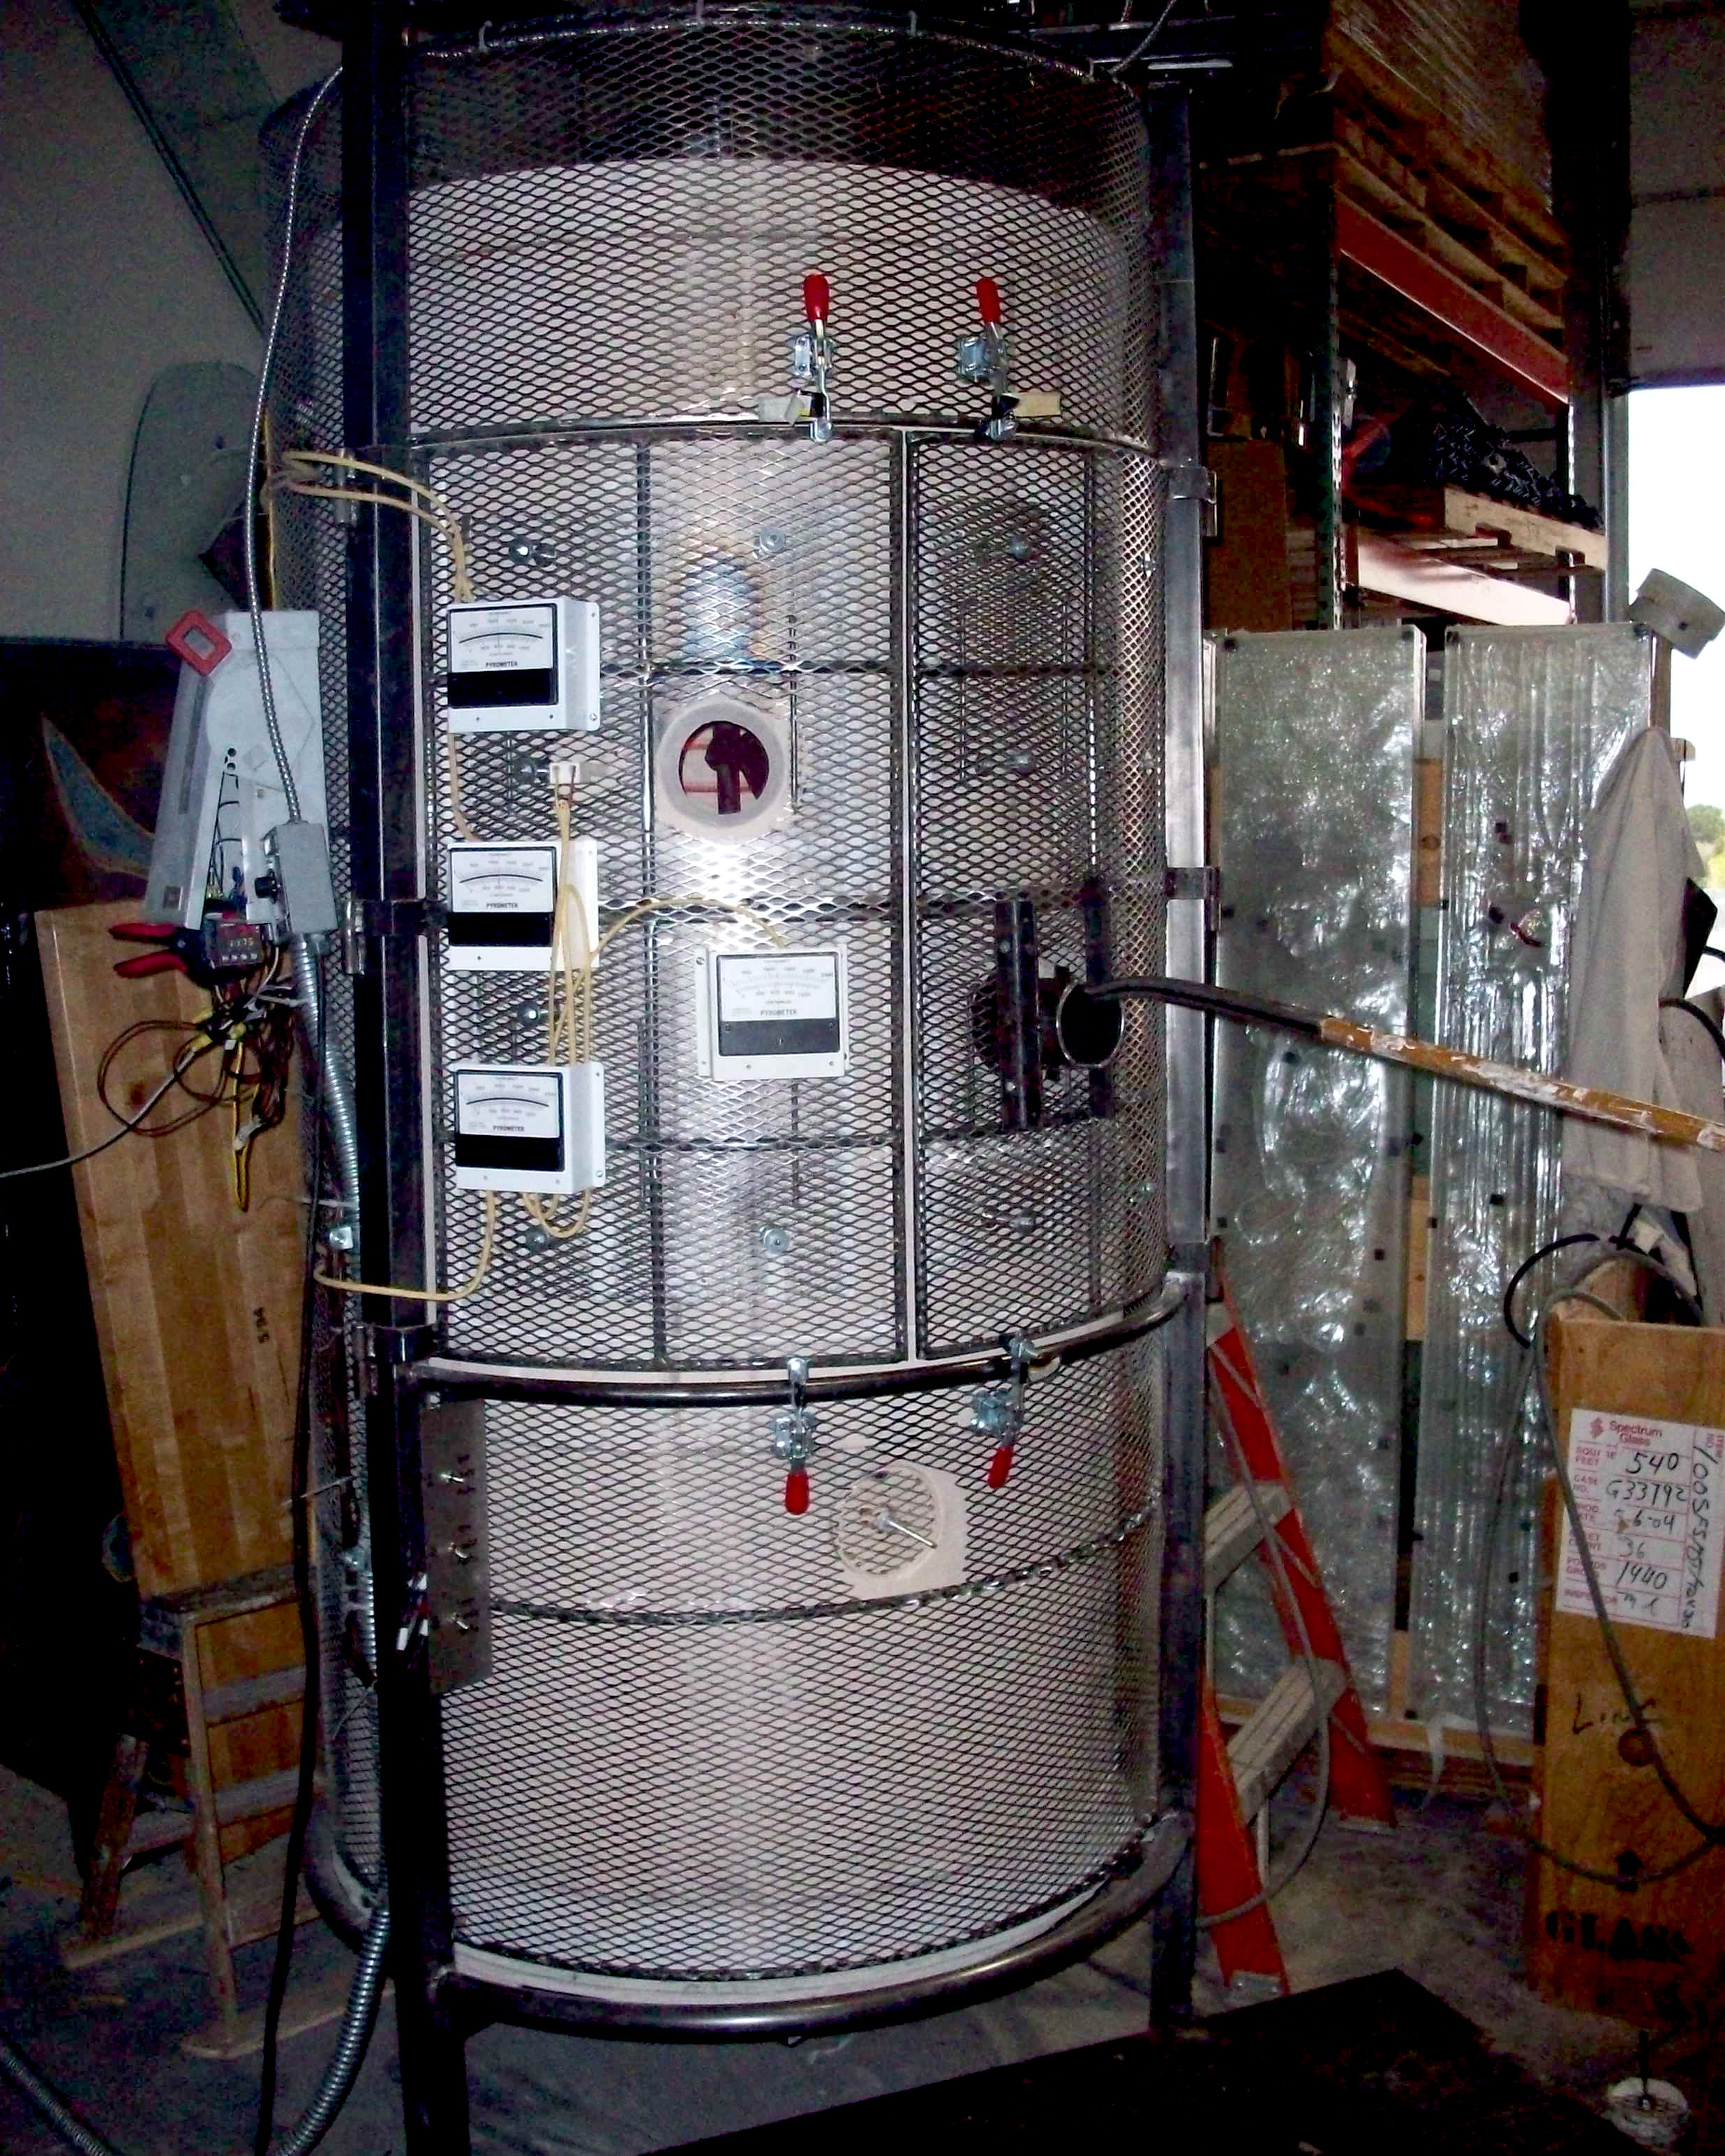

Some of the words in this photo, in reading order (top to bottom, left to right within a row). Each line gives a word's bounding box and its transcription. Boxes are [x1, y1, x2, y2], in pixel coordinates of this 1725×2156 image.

[1609, 1421, 1662, 1438] Spectrum
[1620, 1433, 1650, 1446] Glass
[1625, 1452, 1678, 1476] 540
